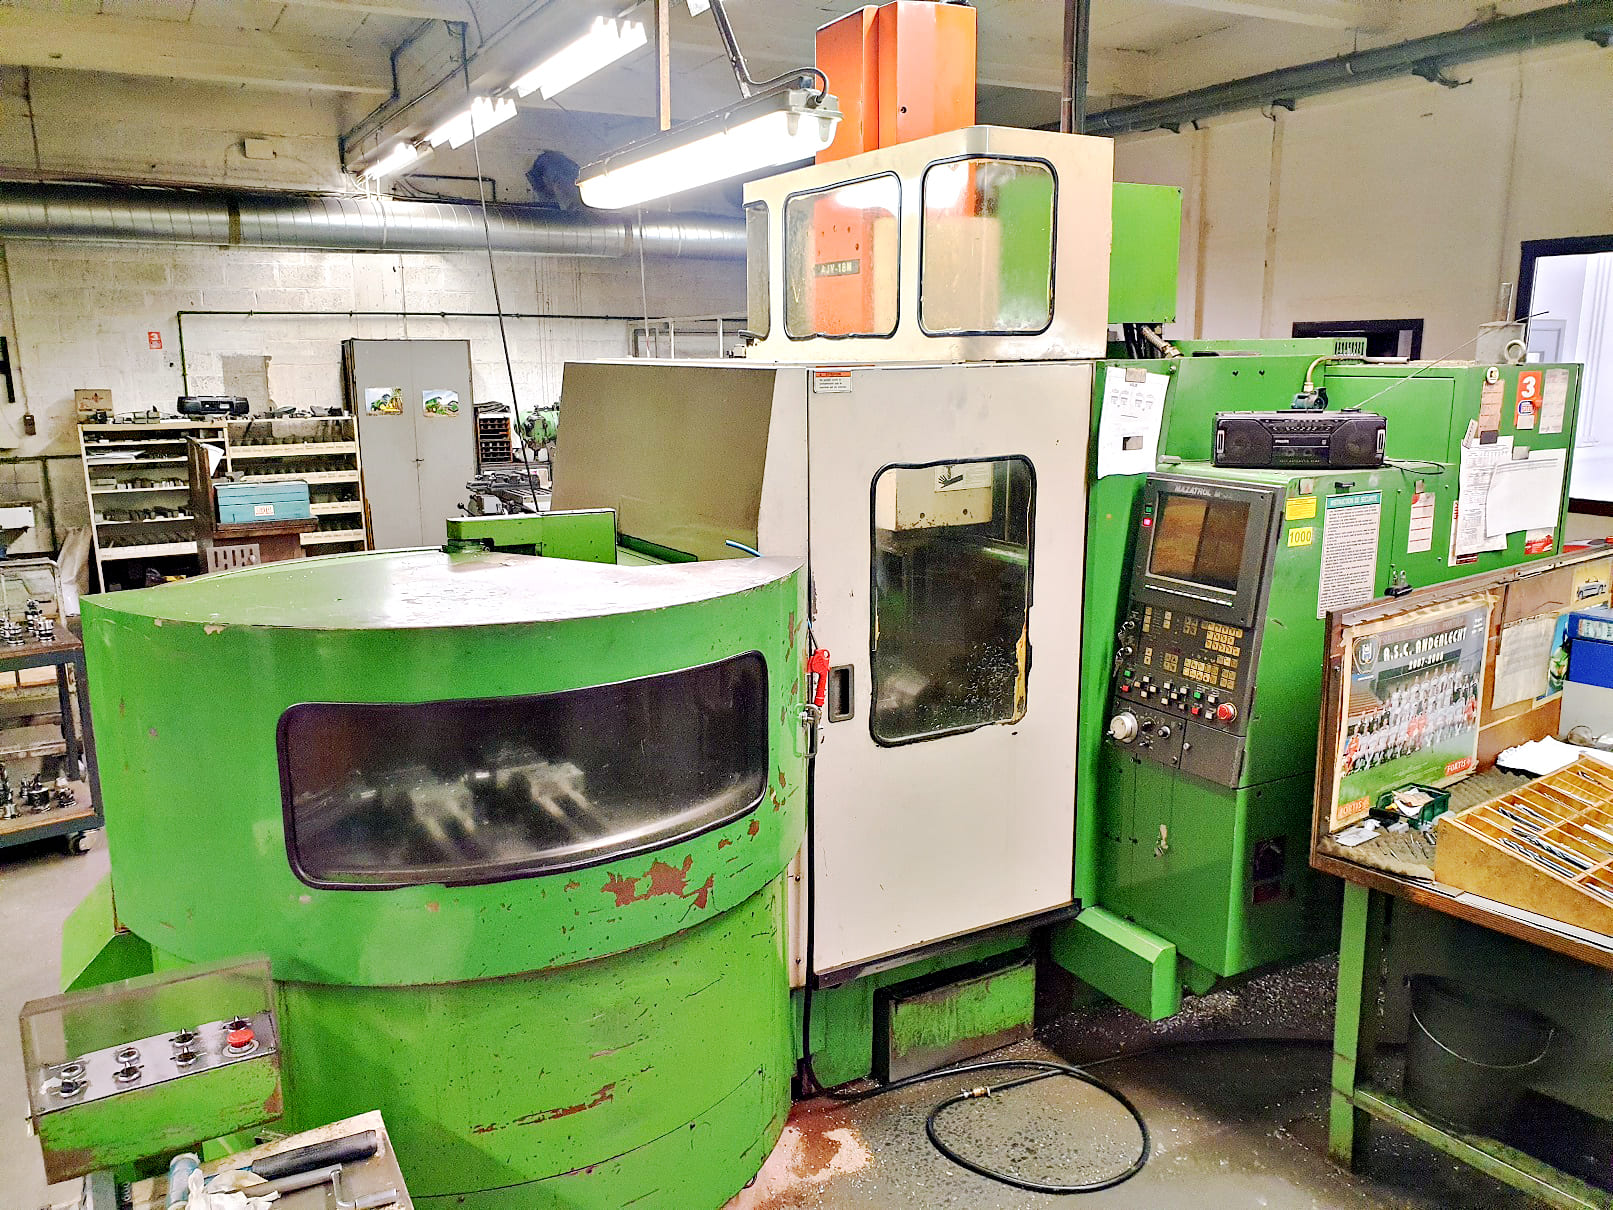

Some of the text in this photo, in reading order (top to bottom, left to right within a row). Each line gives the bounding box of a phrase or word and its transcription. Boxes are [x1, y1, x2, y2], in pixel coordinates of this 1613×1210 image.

[1521, 376, 1536, 398] 3
[1290, 531, 1311, 543] 1000
[1446, 759, 1466, 772] FORTIS
